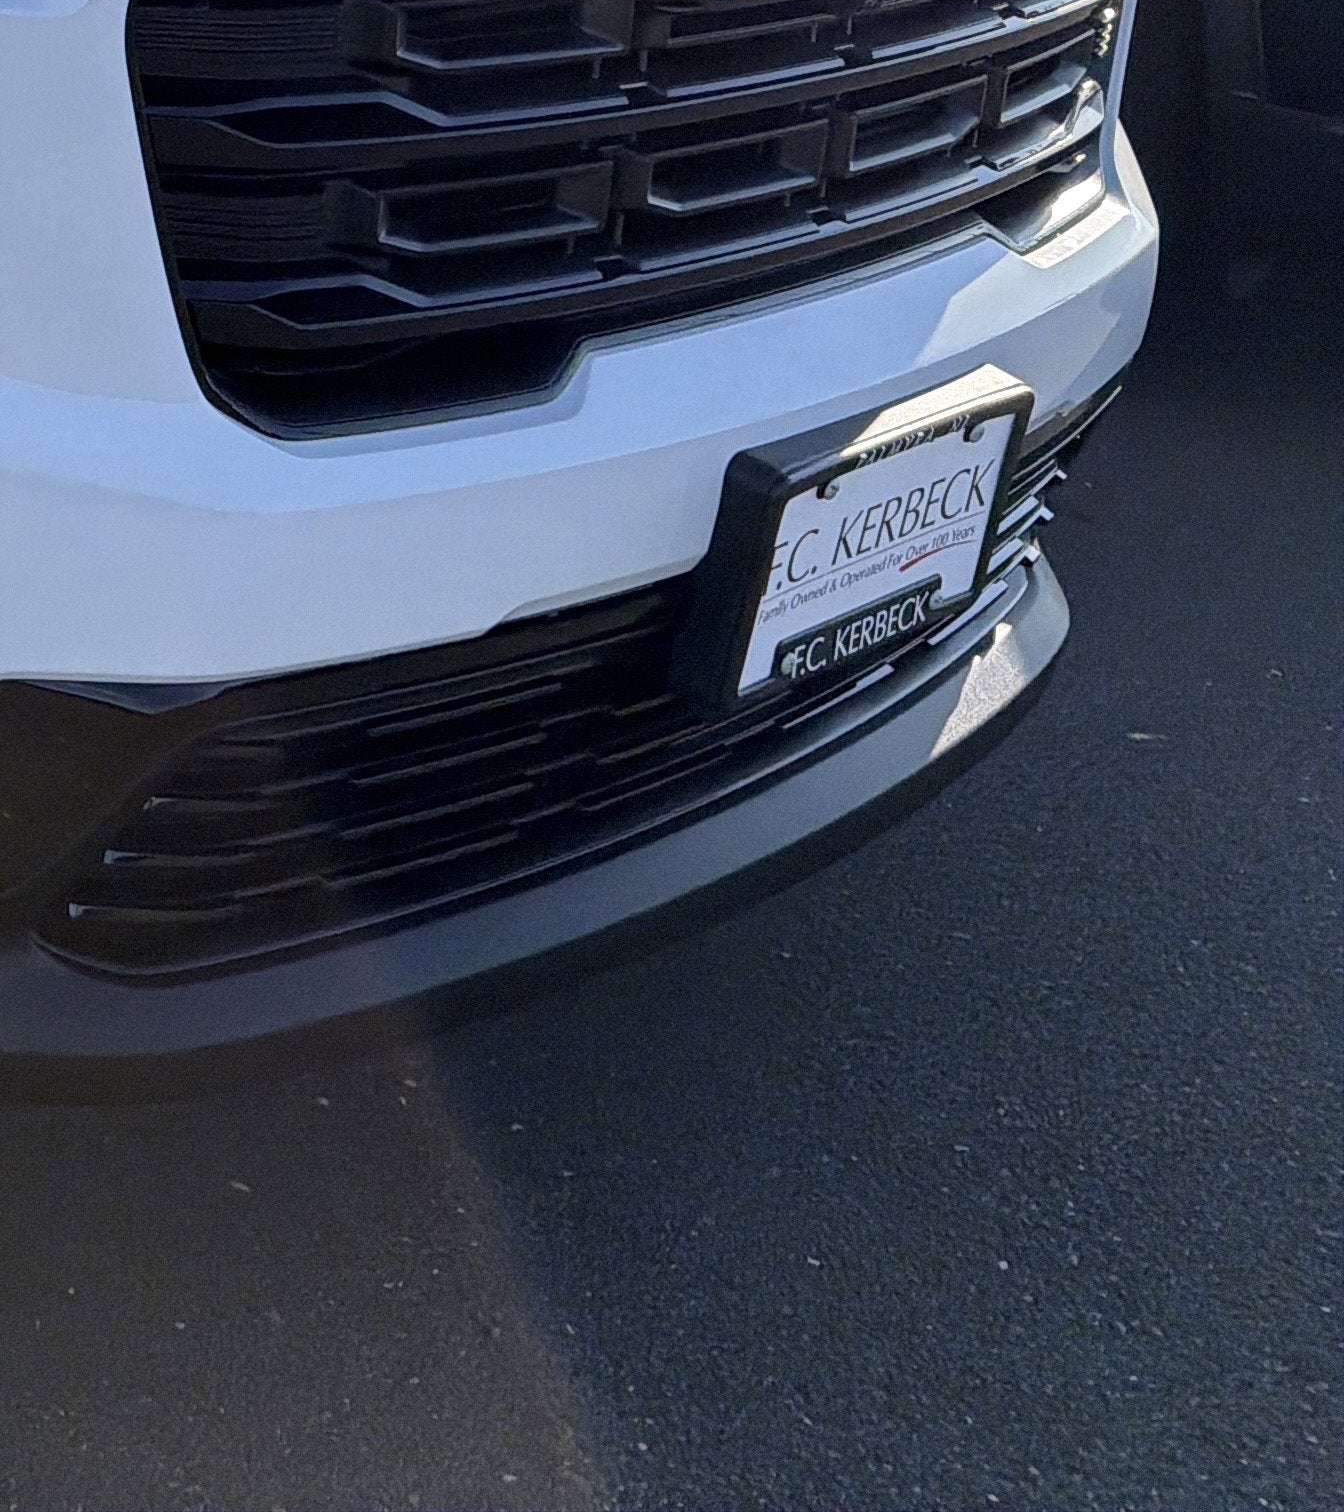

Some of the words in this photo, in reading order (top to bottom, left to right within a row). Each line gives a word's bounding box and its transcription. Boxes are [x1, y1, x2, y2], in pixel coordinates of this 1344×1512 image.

[831, 459, 996, 566] KERBECK
[791, 580, 829, 610] Owned
[932, 531, 950, 550] 100
[792, 636, 828, 679] F.C.
[833, 590, 931, 662] KERBECK
